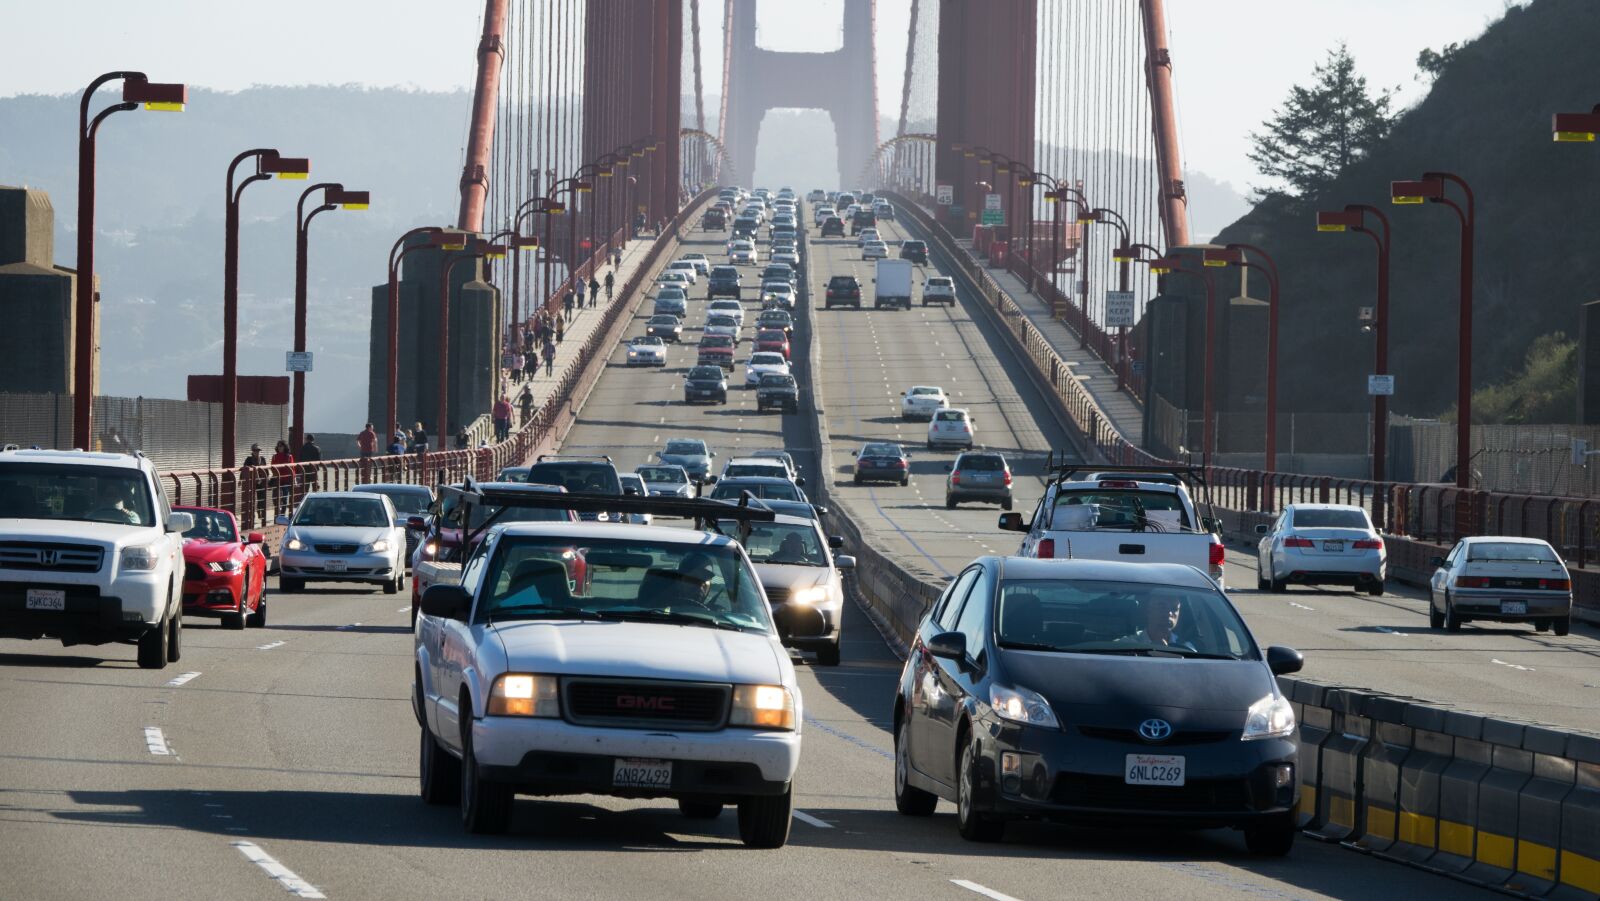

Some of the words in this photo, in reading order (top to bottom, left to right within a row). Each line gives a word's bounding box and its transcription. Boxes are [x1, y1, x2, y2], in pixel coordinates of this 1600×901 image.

[938, 195, 951, 203] 45
[617, 695, 676, 709] GMC
[615, 767, 670, 785] 6N82499
[1130, 765, 1182, 782] 6NLC269
